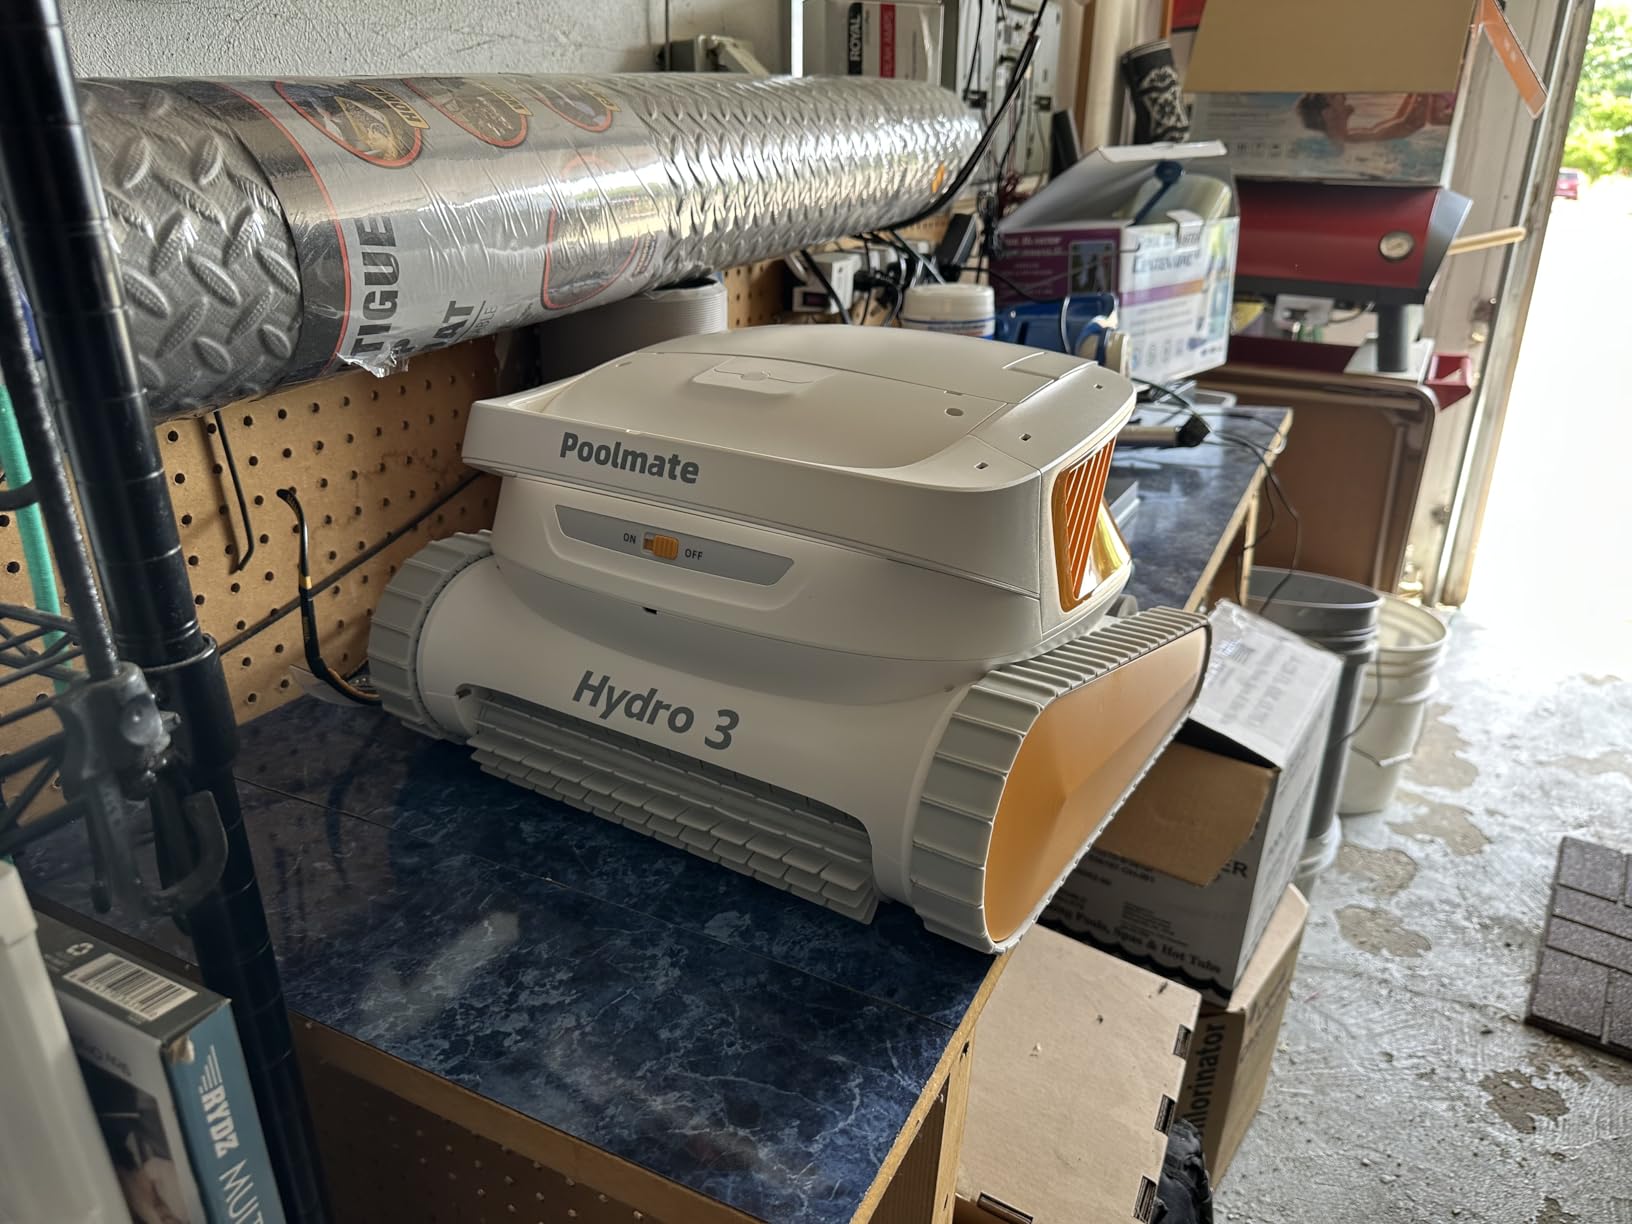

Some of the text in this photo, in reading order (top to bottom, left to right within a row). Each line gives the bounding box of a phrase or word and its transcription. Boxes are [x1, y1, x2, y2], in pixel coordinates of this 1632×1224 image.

[849, 15, 862, 62] ROYAL
[350, 216, 401, 356] TIGUE
[560, 432, 700, 485] Poolmate
[623, 533, 704, 561] ON OFF
[572, 671, 740, 751] Hydro 3
[1161, 943, 1186, 962] Hot
[1182, 1024, 1225, 1134] hlorinator
[200, 1086, 240, 1159] RYDZ
